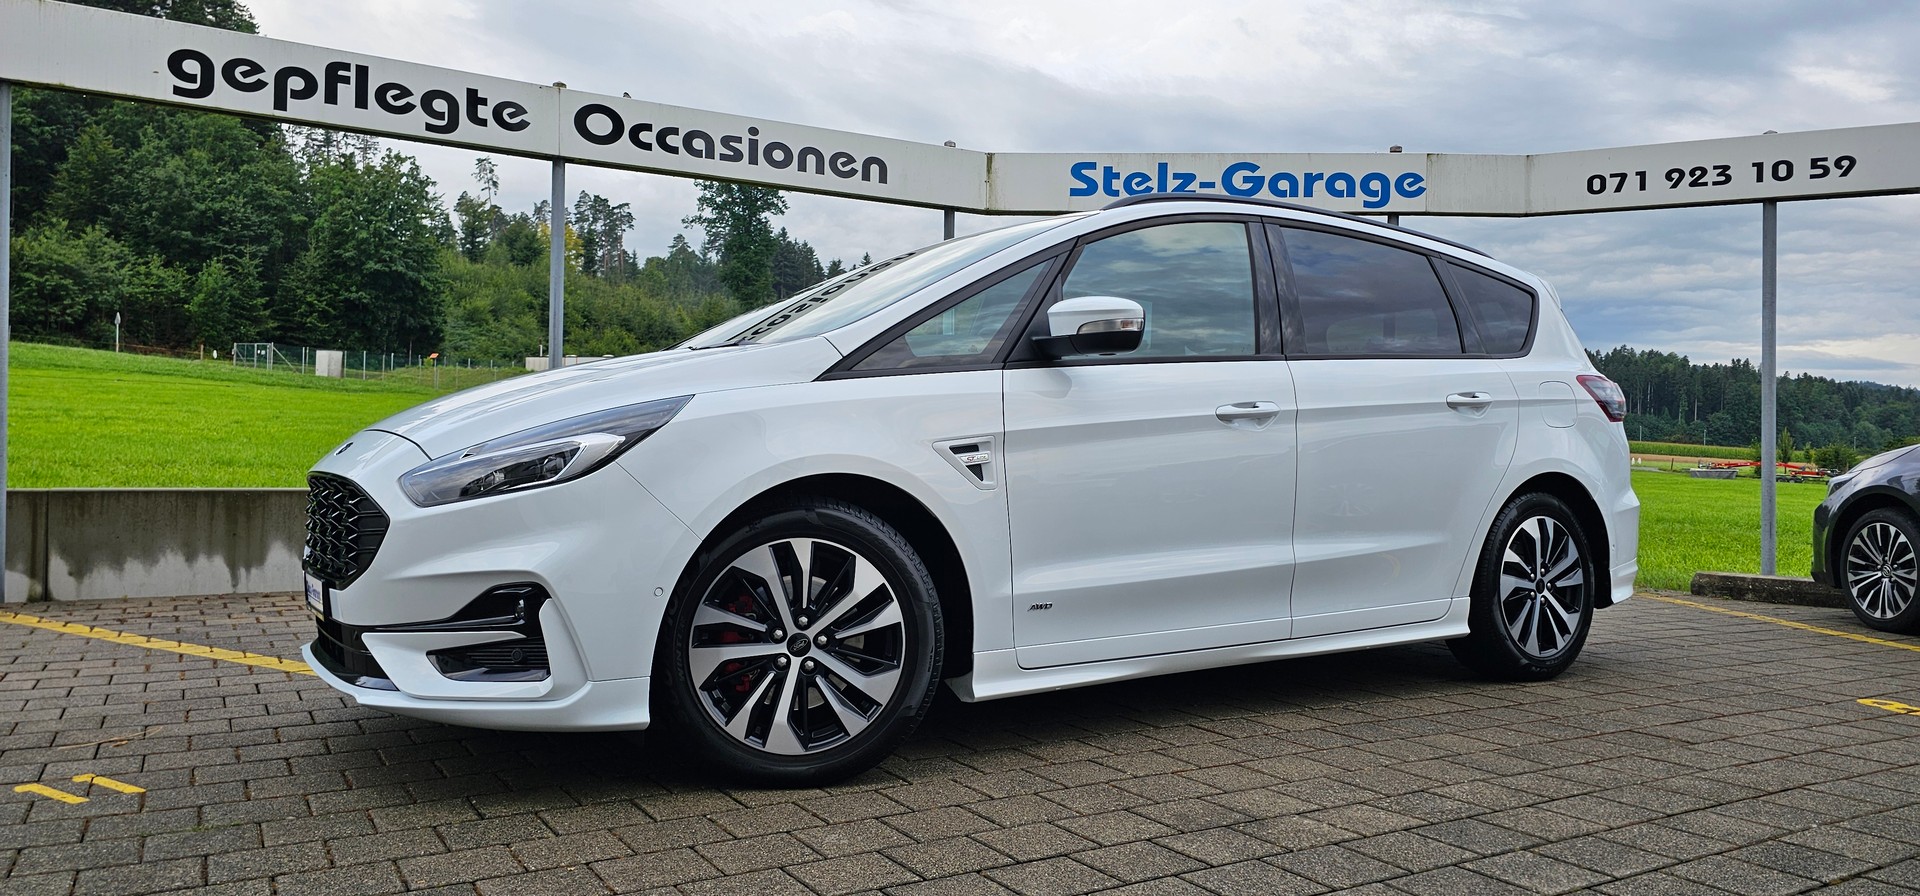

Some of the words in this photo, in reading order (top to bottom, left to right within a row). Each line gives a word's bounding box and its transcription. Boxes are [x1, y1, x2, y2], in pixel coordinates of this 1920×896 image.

[166, 48, 532, 134] gepflegte
[573, 103, 888, 185] Occasionen
[1069, 161, 1426, 209] Stelz-Garage
[1586, 173, 1647, 196] 071
[1664, 164, 1733, 190] 923
[1751, 159, 1794, 184] 10
[1809, 154, 1857, 180] 59
[1027, 602, 1053, 612] AWD
